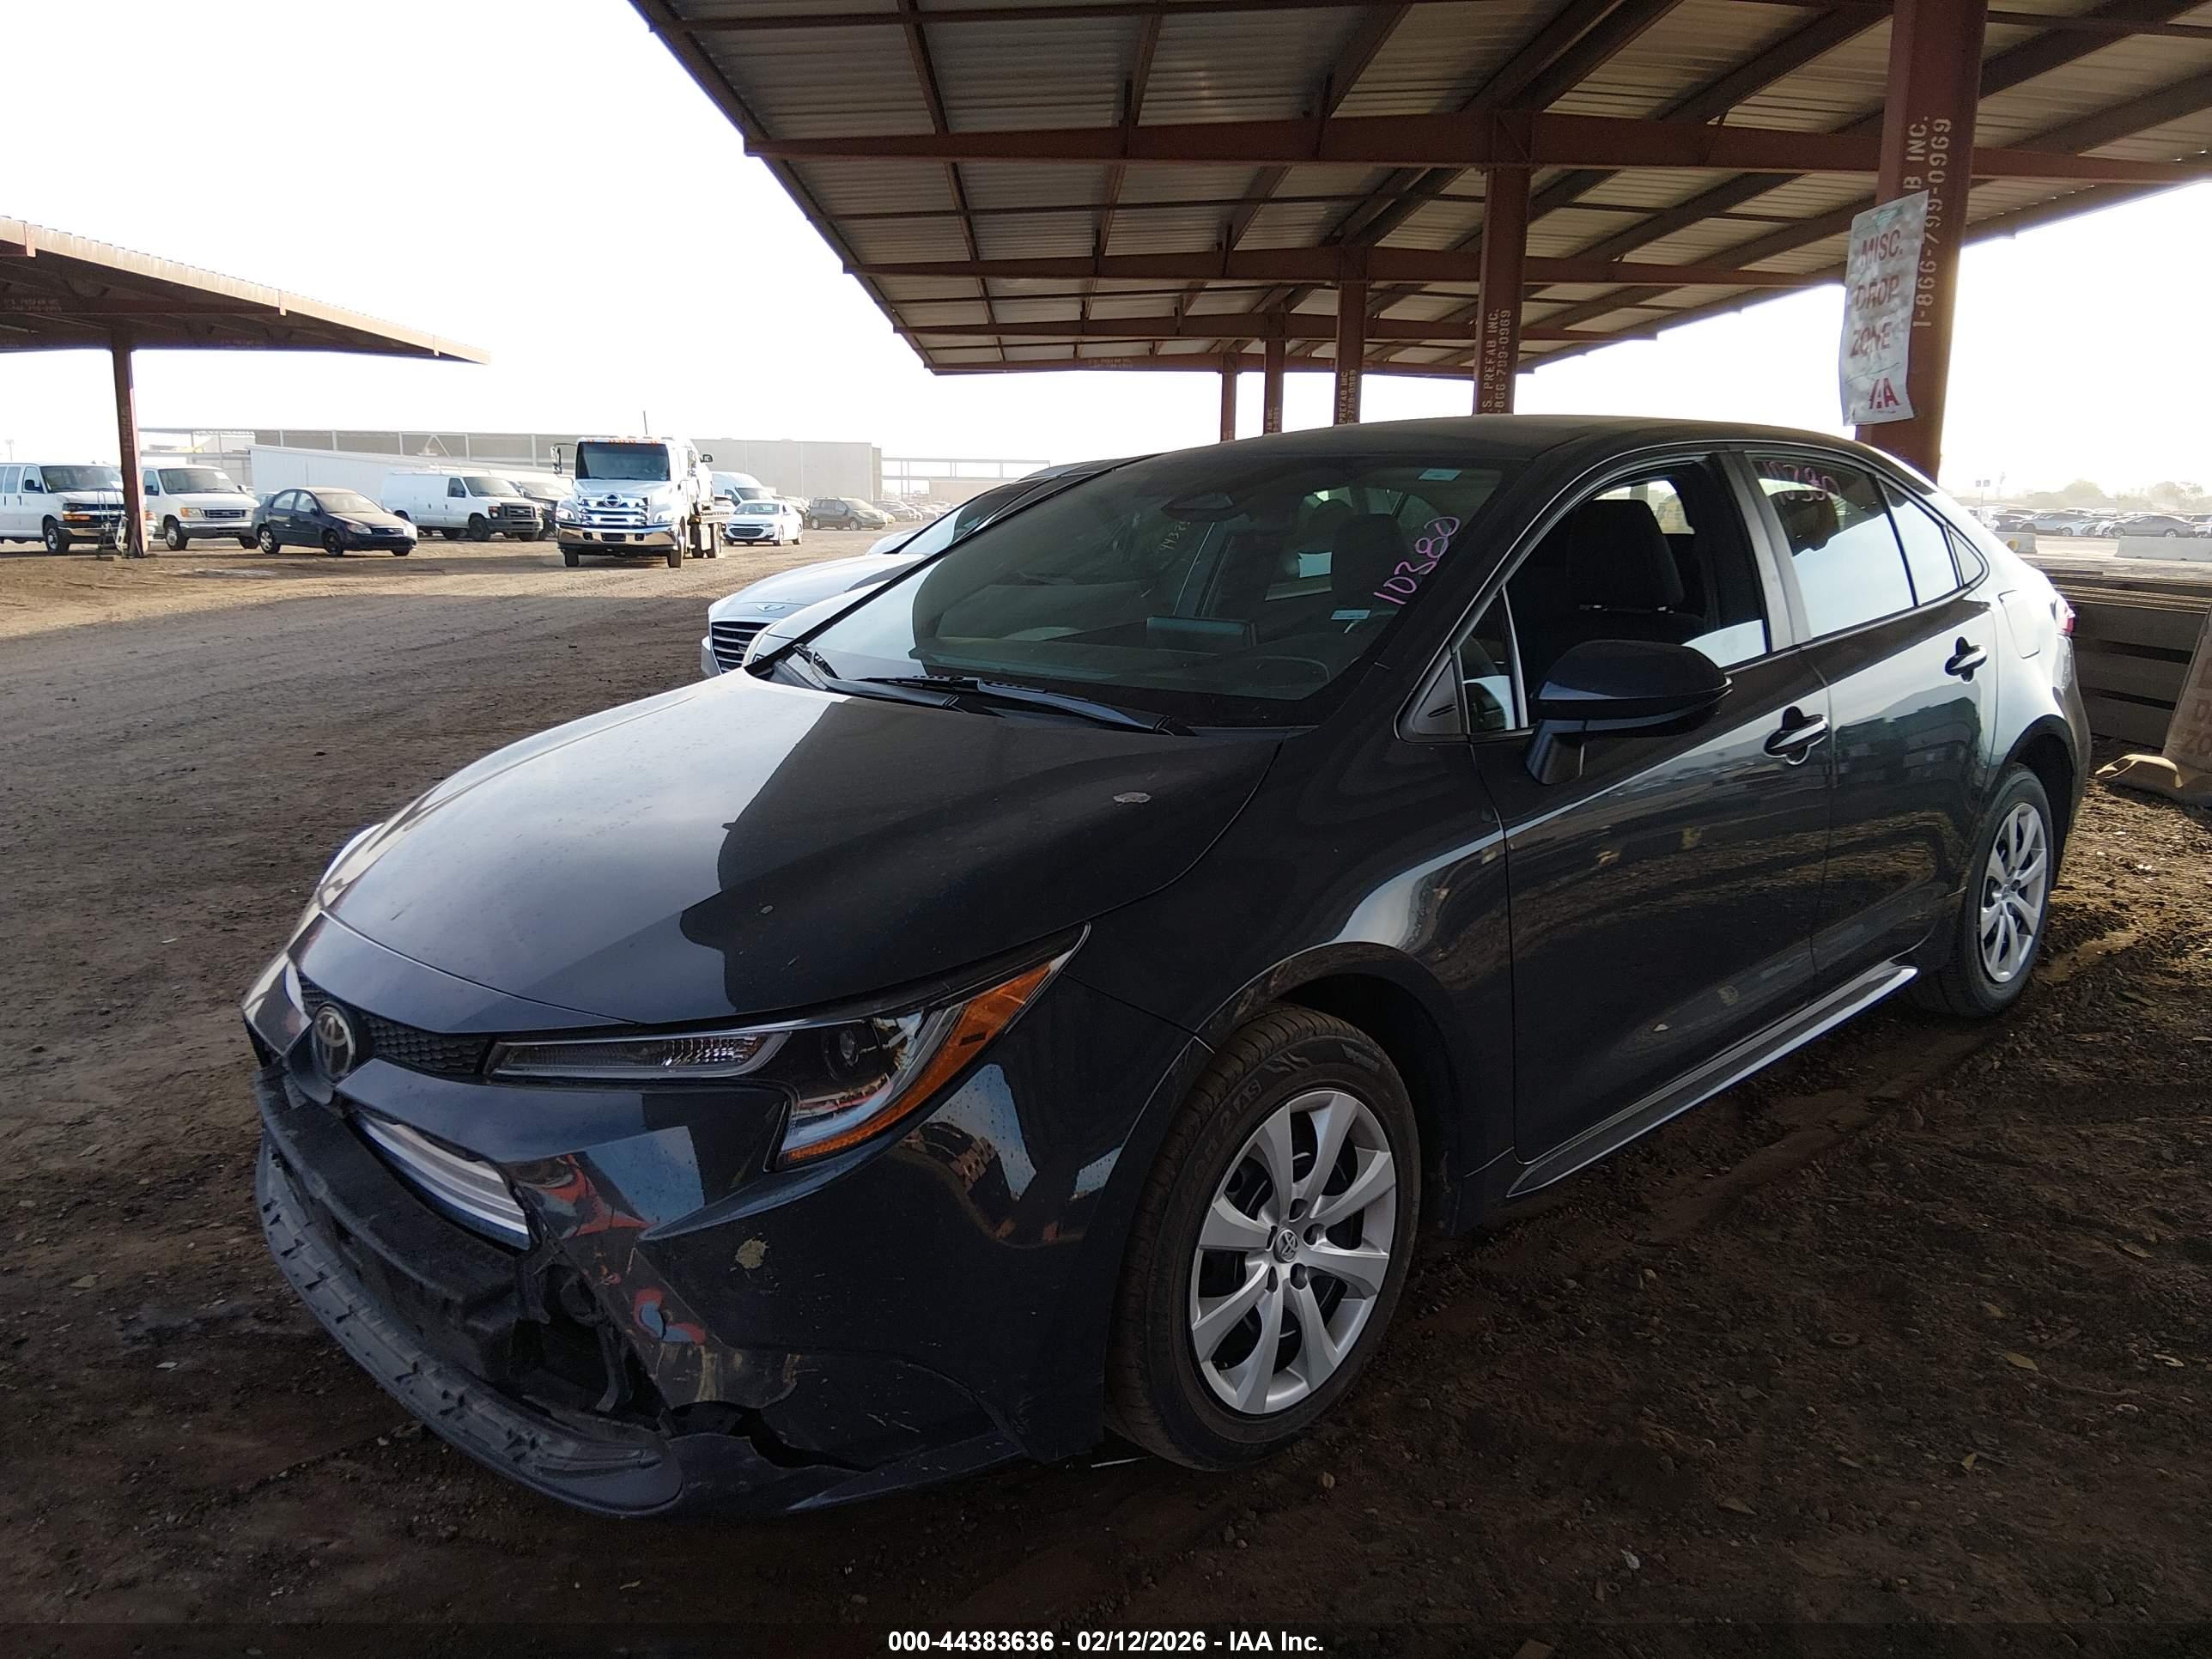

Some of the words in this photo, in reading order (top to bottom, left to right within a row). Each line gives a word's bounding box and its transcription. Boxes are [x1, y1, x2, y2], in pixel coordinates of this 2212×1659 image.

[1905, 116, 1929, 161] INC.
[1903, 176, 1922, 191] B
[1859, 228, 1904, 268] MISC.
[1855, 274, 1900, 311] DROP
[1486, 308, 1500, 333] INC.
[1850, 320, 1893, 358] ZONE
[1483, 340, 1498, 390] PREFAB
[1493, 309, 1512, 413] -866-799-0969
